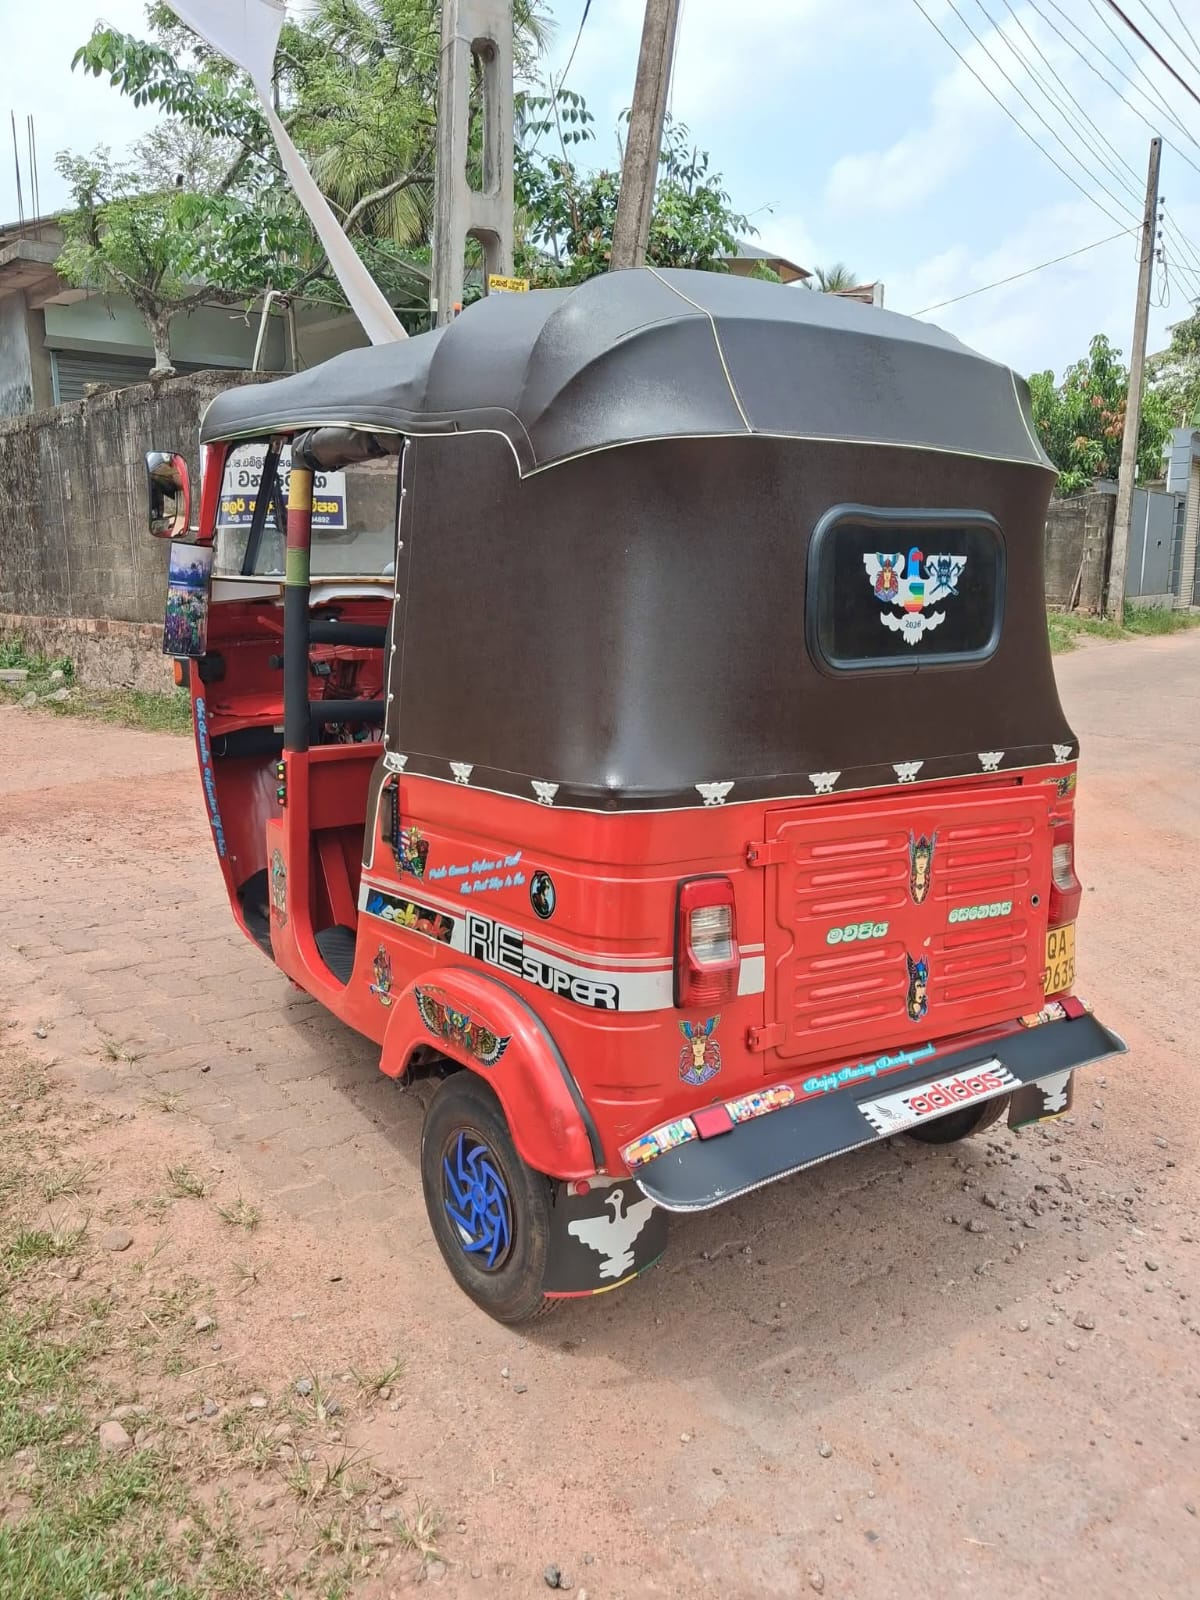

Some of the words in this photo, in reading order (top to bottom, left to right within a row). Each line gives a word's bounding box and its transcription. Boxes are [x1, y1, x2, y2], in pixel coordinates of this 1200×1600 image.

[466, 910, 523, 978] RE
[522, 957, 618, 1010] SUPER
[909, 1073, 1004, 1114] adidas
